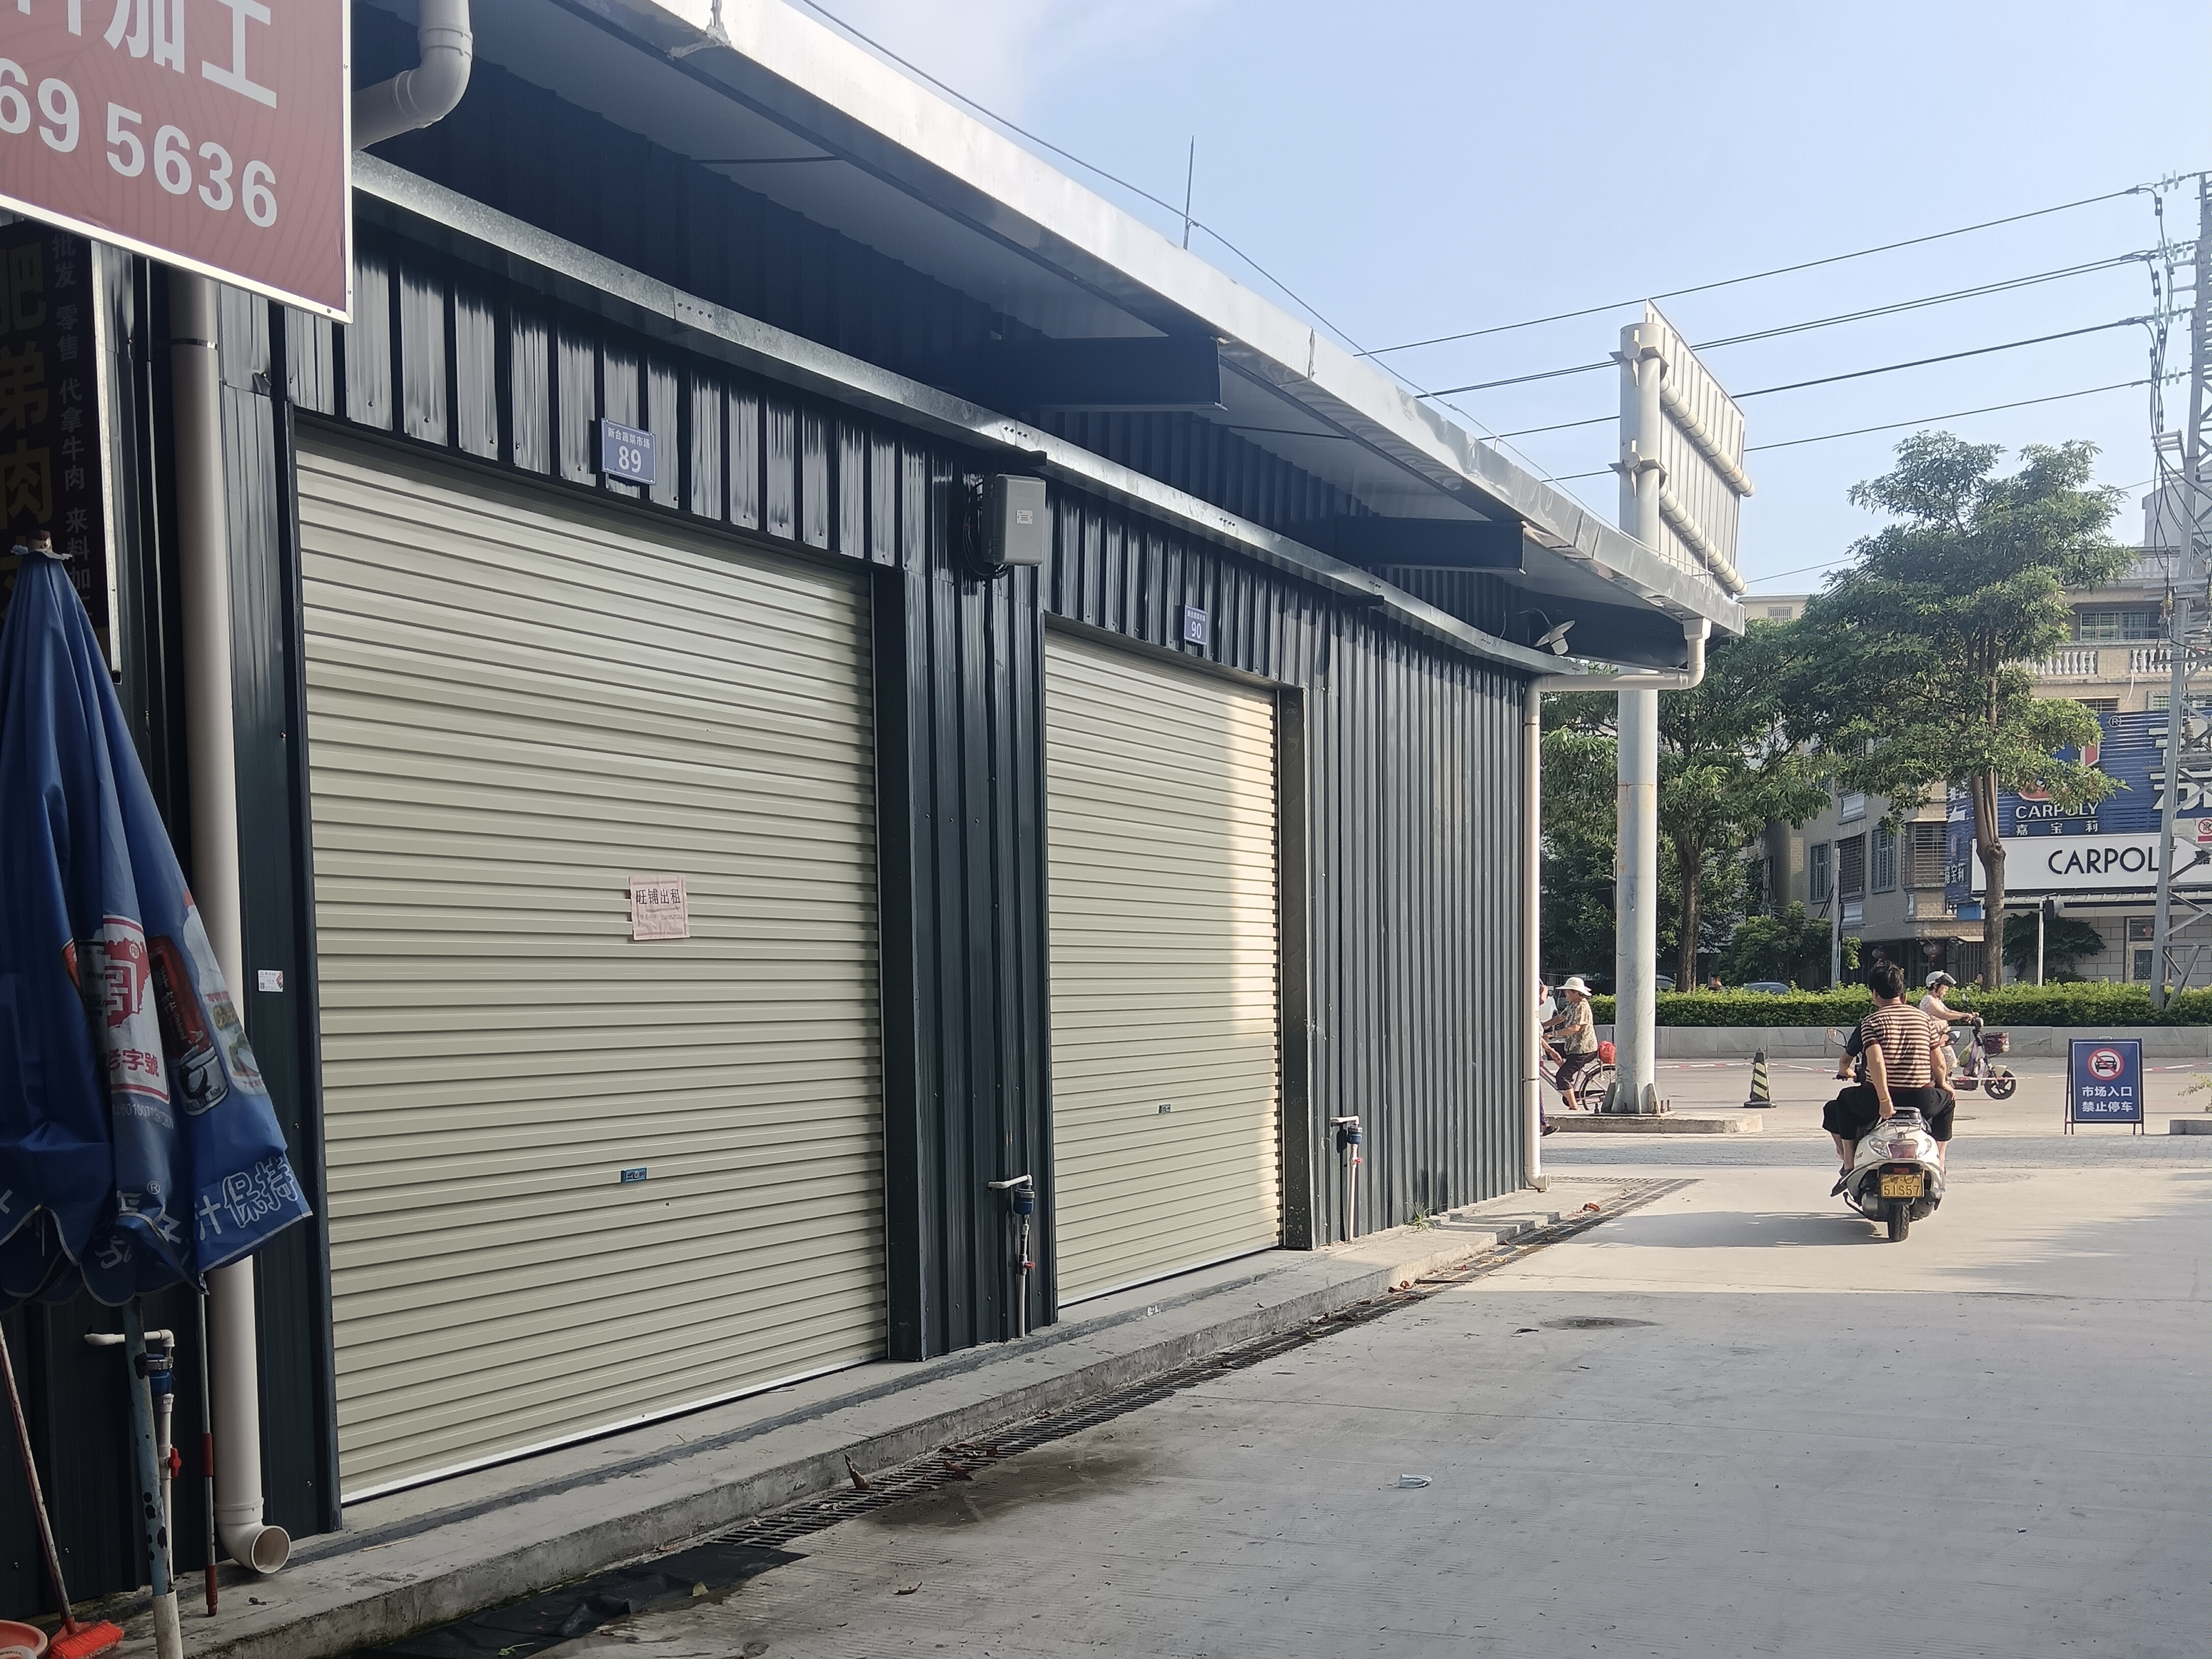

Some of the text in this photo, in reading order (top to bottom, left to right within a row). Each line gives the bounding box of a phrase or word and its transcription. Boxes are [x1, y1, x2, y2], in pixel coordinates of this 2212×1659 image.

[18, 0, 277, 109] 加工
[106, 102, 278, 228] 5636
[618, 445, 642, 473] 89
[1191, 621, 1202, 639] 90
[2048, 846, 2159, 874] CARPOL
[636, 888, 681, 904] 旺铺出租
[2081, 1086, 2132, 1097] 市场入口
[2082, 1101, 2133, 1112] 禁止停车
